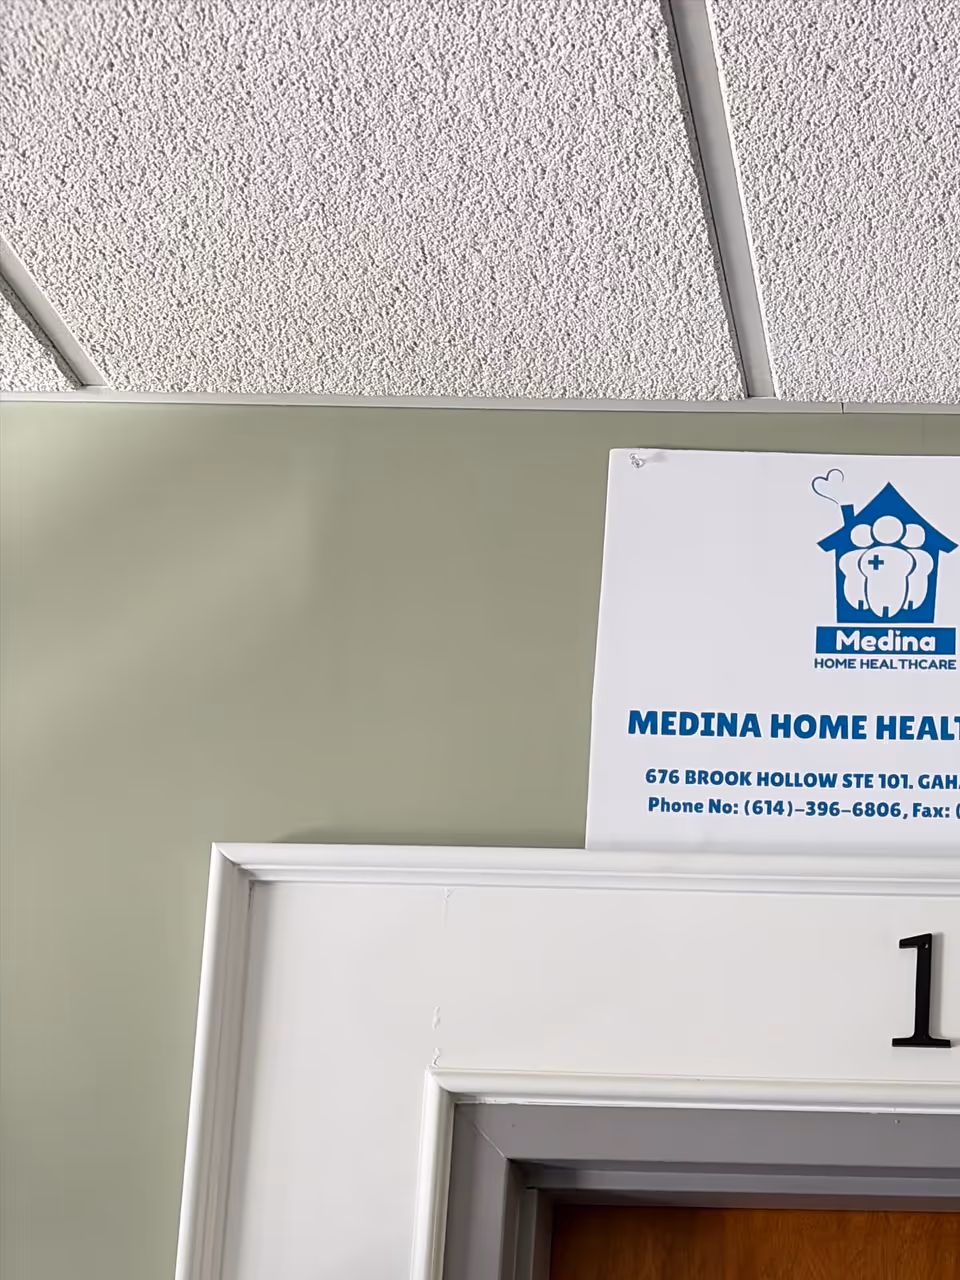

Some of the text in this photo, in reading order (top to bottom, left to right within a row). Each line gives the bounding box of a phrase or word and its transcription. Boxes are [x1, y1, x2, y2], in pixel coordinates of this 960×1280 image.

[836, 629, 936, 652] Medina
[814, 658, 957, 670] HOME HEALTHCARE
[628, 710, 762, 738] MEDINA
[770, 713, 868, 740] HOME
[645, 768, 680, 784] 676
[685, 769, 752, 787] BROOK
[756, 771, 838, 788] HOLLOW
[842, 773, 874, 789] STE
[878, 773, 914, 789] 101.
[648, 797, 704, 813] Phone
[708, 798, 739, 814] No:
[912, 802, 950, 818] Fax:
